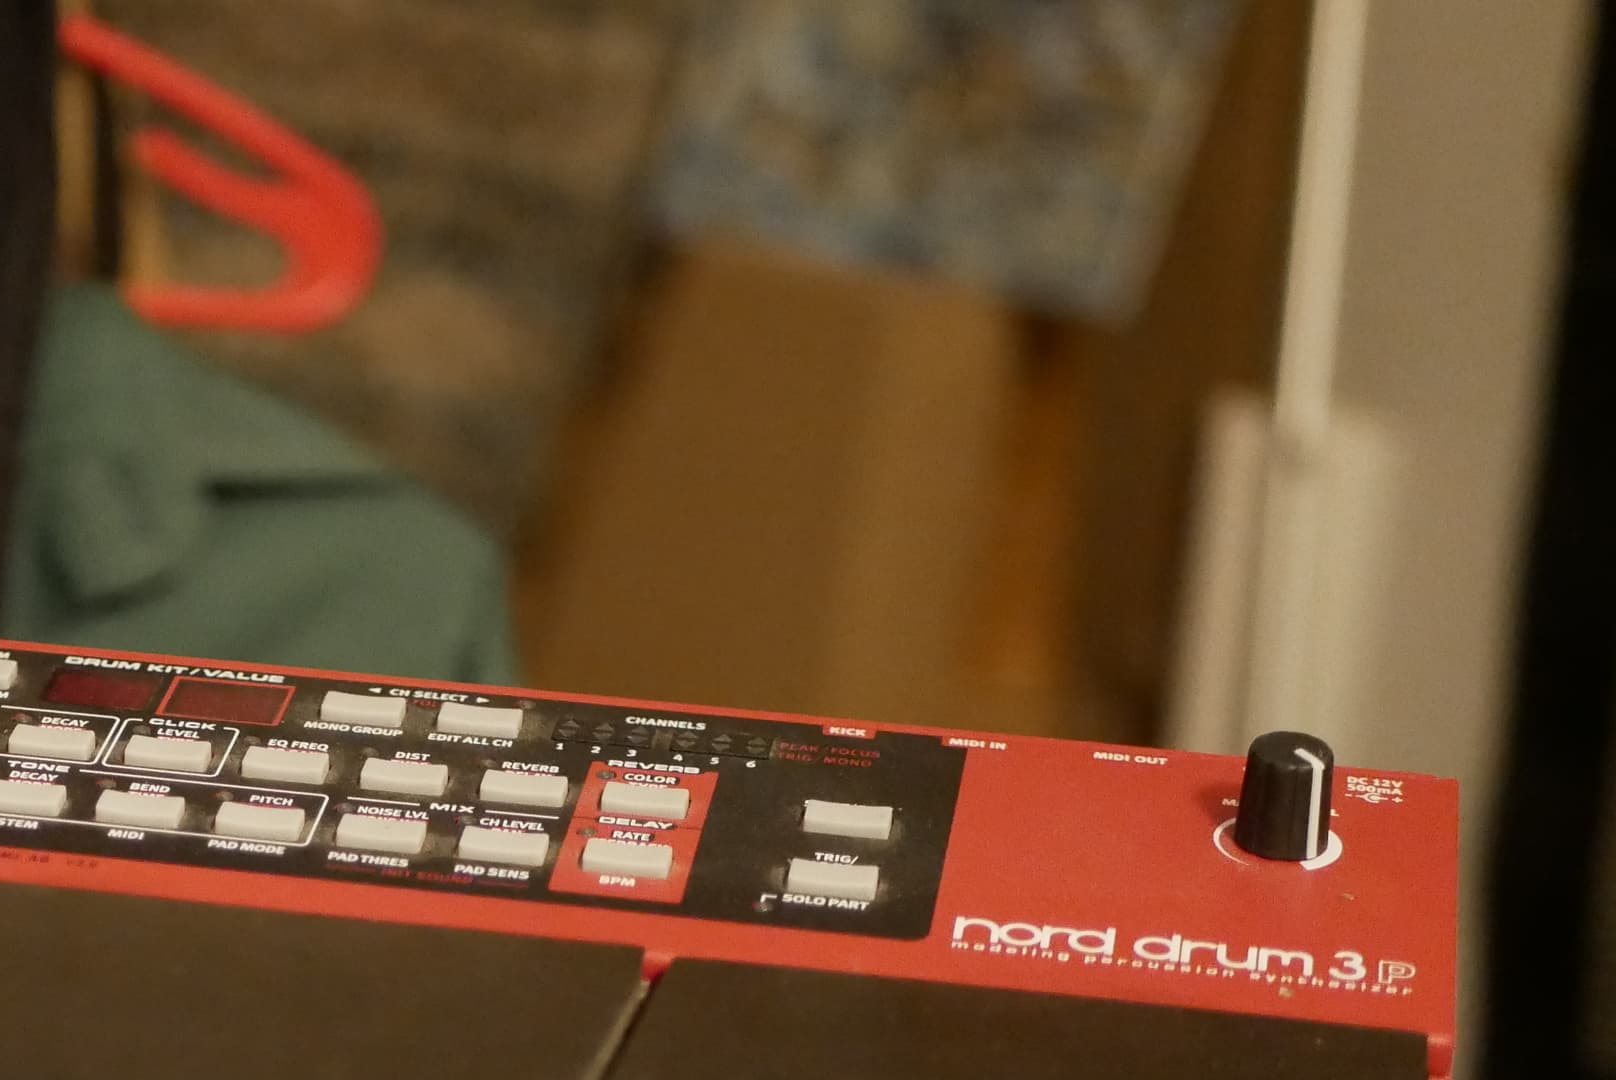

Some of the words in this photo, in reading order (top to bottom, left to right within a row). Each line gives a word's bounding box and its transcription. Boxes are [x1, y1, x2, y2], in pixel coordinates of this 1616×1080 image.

[65, 656, 141, 671] DRUM
[389, 688, 410, 698] CH
[412, 690, 469, 703] SELECT
[41, 716, 90, 728] DECAY
[148, 718, 217, 731] CLICK
[625, 716, 706, 731] CHANNELS
[157, 728, 200, 739] LEVEL
[304, 721, 350, 732] MONO
[352, 725, 404, 737] GROUP
[829, 726, 866, 737] KICK
[267, 739, 288, 749] EQ
[291, 741, 329, 751] FREQ
[428, 733, 462, 743] EDIT
[462, 737, 489, 746] ALL
[492, 739, 513, 748] CH
[948, 737, 986, 748] MIDI
[989, 741, 1007, 750] IN
[395, 751, 431, 761] DIST
[555, 742, 564, 751] 1
[590, 746, 601, 754] 2
[626, 749, 637, 758] 3
[673, 754, 683, 762] 4
[709, 757, 720, 765] 5
[746, 760, 756, 768] 6
[1093, 751, 1130, 762] MIDI
[1134, 755, 1168, 765] OUT
[7, 760, 71, 773] TONE
[502, 761, 560, 774] REVERB
[608, 759, 700, 774] REVERB
[9, 770, 59, 782] DECAY
[624, 773, 677, 785] COLOR
[1347, 776, 1368, 786] DC
[1373, 778, 1403, 788] 12V
[129, 782, 171, 794] BEND
[1347, 783, 1403, 796] 500mA
[249, 794, 294, 806] PITCH
[357, 805, 402, 817] NOISE
[405, 810, 430, 820] LVL
[429, 802, 476, 814] MIX
[479, 817, 501, 827] CH
[502, 820, 545, 832] LEVEL
[598, 816, 673, 830] DELAY
[107, 829, 146, 841] MIDI
[612, 830, 651, 842] RATE
[208, 838, 238, 849] PAD
[239, 843, 286, 855] MODE
[328, 851, 359, 863] PAD
[360, 854, 409, 868] THRES
[454, 864, 485, 876] PAD
[486, 867, 530, 880] SENS
[599, 875, 636, 887] BPM
[782, 893, 826, 906] SOLO
[828, 899, 870, 911] PART
[951, 940, 1070, 963] modeling
[952, 915, 1117, 956] nord
[1133, 933, 1315, 977] drum
[1328, 950, 1367, 982] 3
[1378, 959, 1417, 985] P
